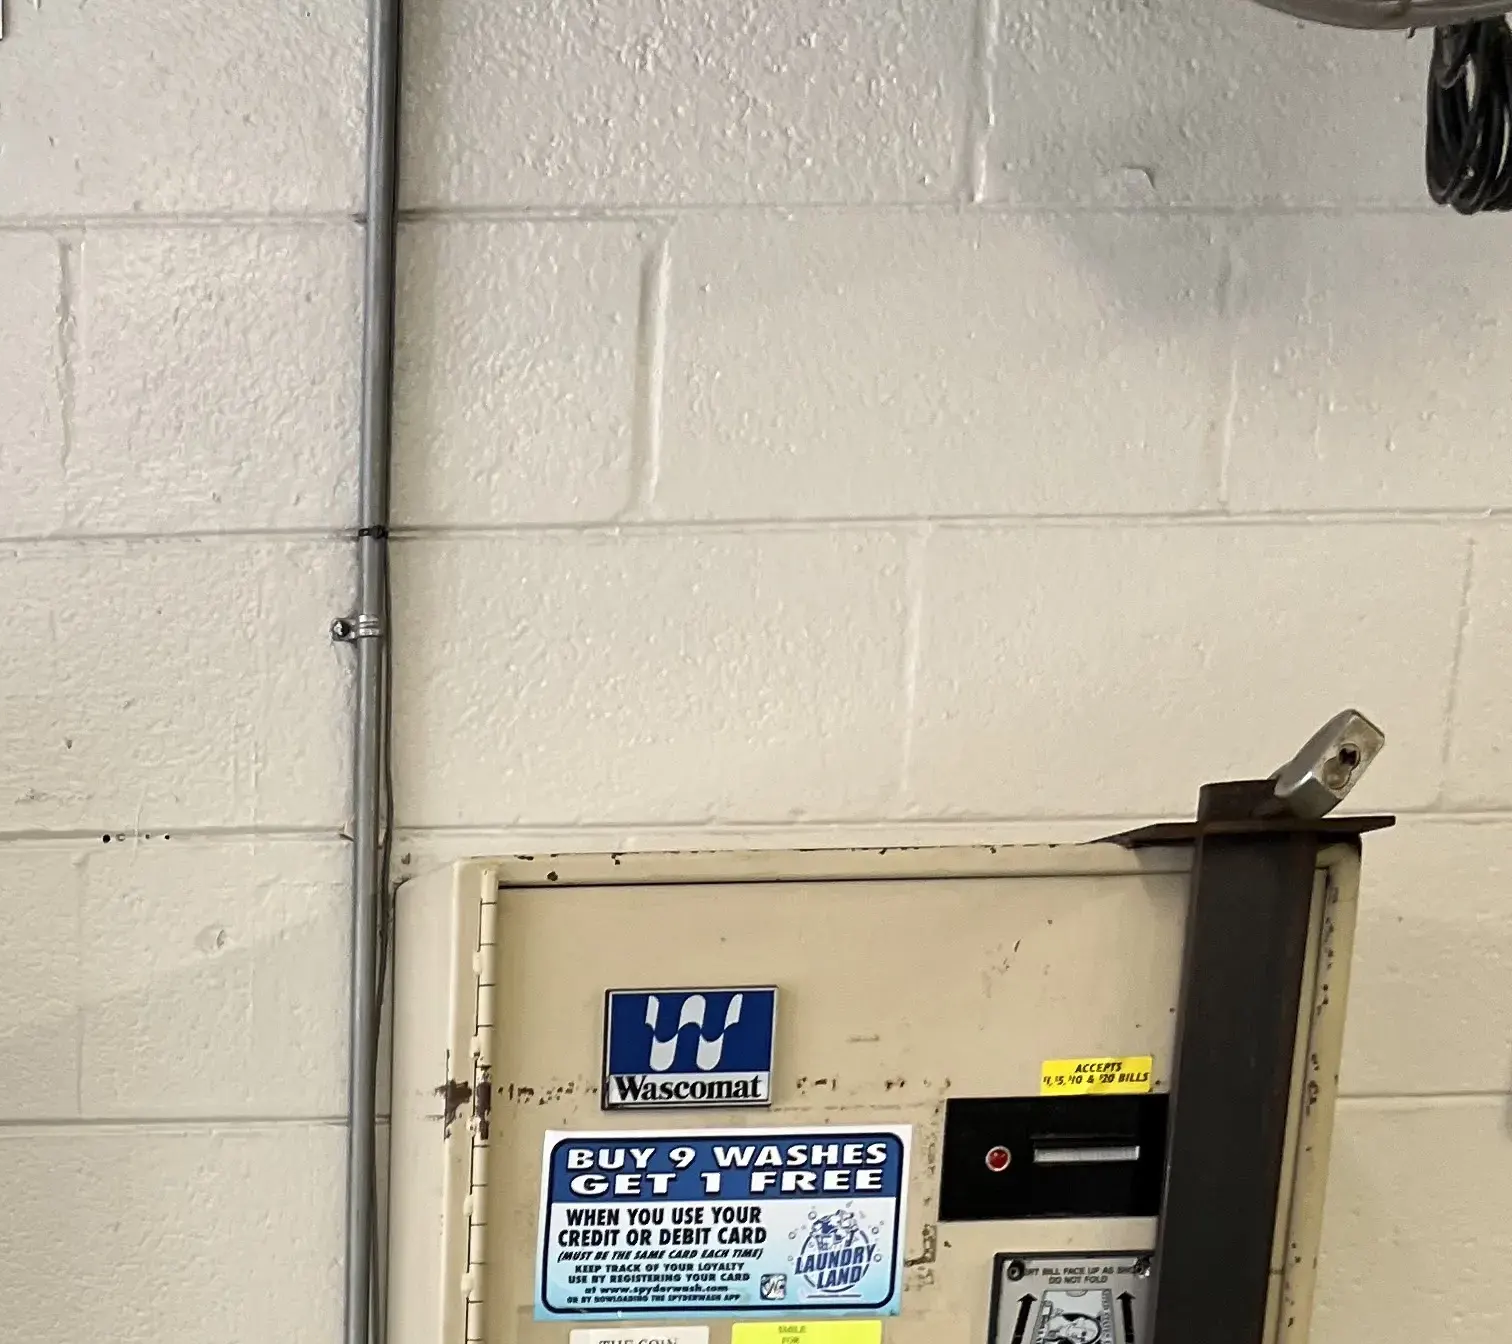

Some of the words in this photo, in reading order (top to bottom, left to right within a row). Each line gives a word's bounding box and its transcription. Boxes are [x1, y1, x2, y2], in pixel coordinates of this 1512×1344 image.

[1075, 1062, 1122, 1073] ACCEPTS
[1087, 1074, 1095, 1083] &
[1118, 1072, 1149, 1083] BILLS
[613, 1075, 762, 1101] Wascomat
[566, 1148, 656, 1170] BUY
[669, 1147, 696, 1168] 9
[713, 1143, 888, 1168] WASHES
[570, 1172, 677, 1195] GET
[701, 1172, 722, 1193] 1
[750, 1168, 884, 1192] FREE
[566, 1208, 620, 1226] WHEN
[626, 1208, 665, 1226] YOU
[671, 1207, 704, 1224] USE
[710, 1206, 761, 1224] YOUR
[558, 1229, 620, 1247] CREDIT
[626, 1229, 652, 1246] OR
[659, 1228, 711, 1245] DEBIT
[717, 1227, 767, 1244] CARD
[557, 1251, 592, 1263] (MUST
[594, 1252, 609, 1260] BE
[611, 1251, 632, 1260] THE
[634, 1250, 664, 1260] SAME
[668, 1250, 698, 1259] CARD
[700, 1249, 728, 1259] EACH
[732, 1248, 764, 1260] TIME)
[795, 1243, 876, 1275] LAUNDRY
[574, 1265, 601, 1273] KEEP
[605, 1264, 641, 1273] TRACK
[645, 1264, 659, 1272] OF
[663, 1263, 694, 1272] YOUR
[698, 1262, 745, 1271] LOYALTY
[568, 1275, 587, 1284] USE
[591, 1275, 606, 1283] BY
[609, 1275, 681, 1283] REGISTERING
[685, 1274, 717, 1282] YOUR
[720, 1273, 751, 1281] CARD
[817, 1266, 863, 1289] LAND
[1048, 1276, 1061, 1285] DO
[1085, 1275, 1108, 1284] FOLD
[584, 1286, 596, 1294] at
[781, 1336, 800, 1344] FOR
